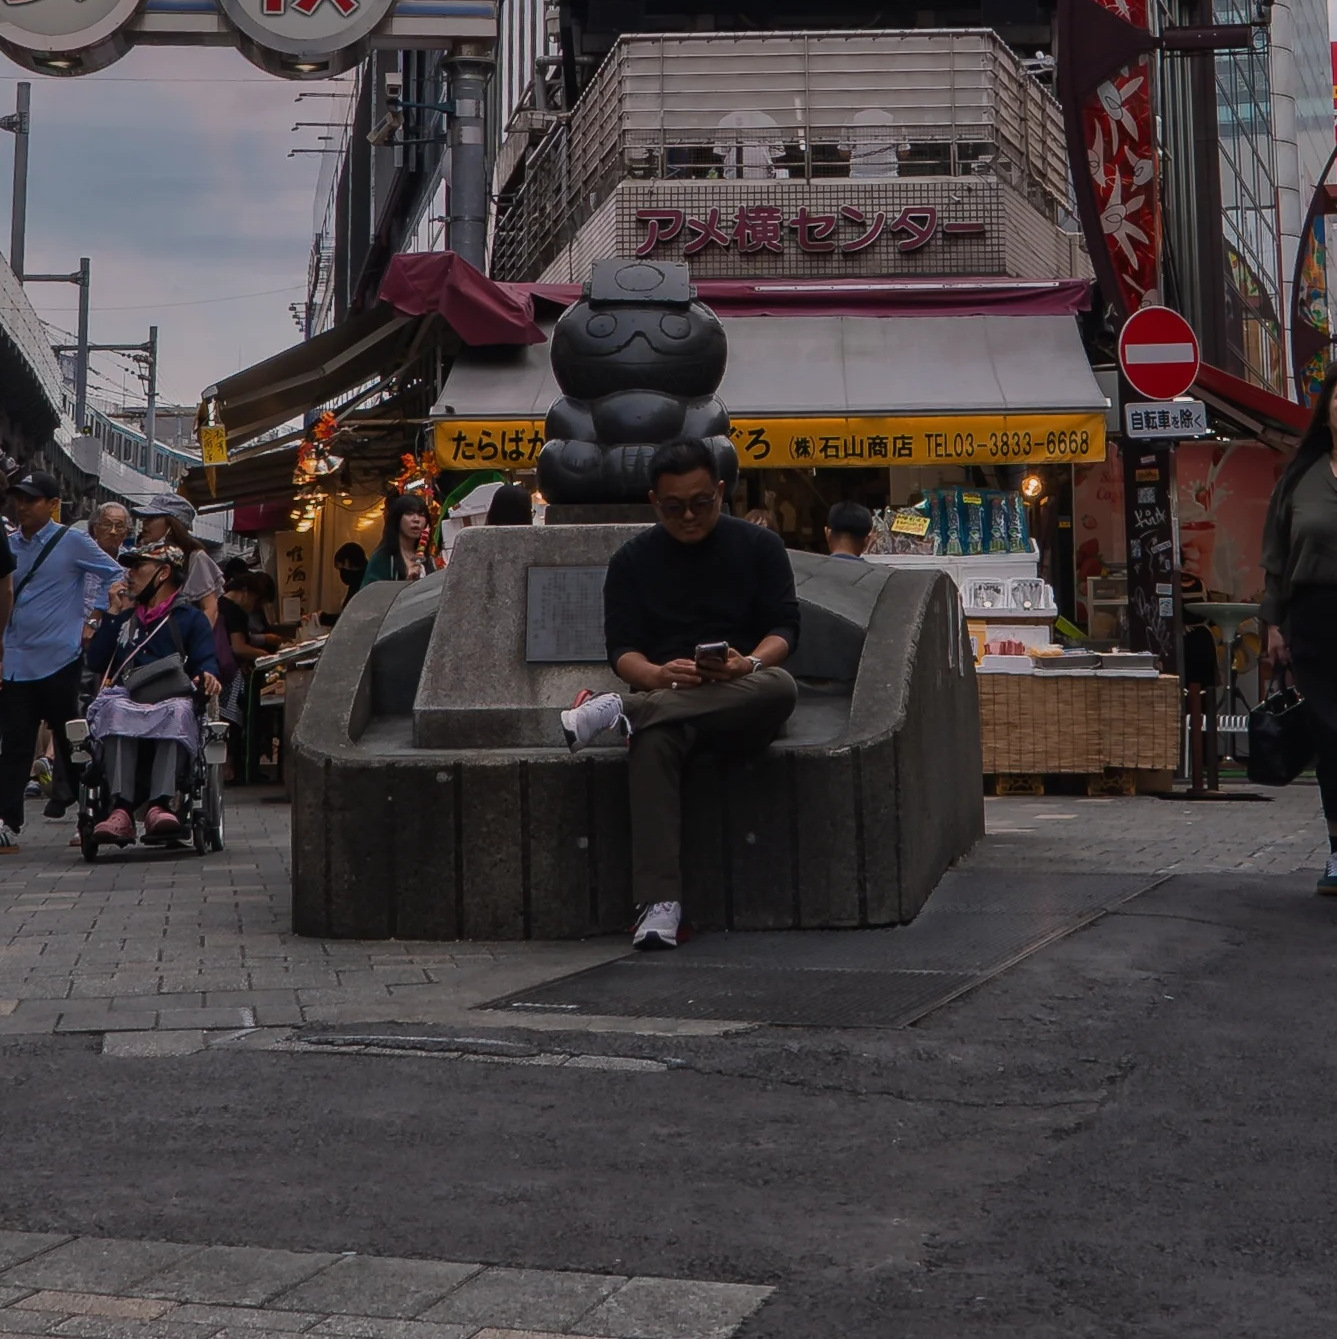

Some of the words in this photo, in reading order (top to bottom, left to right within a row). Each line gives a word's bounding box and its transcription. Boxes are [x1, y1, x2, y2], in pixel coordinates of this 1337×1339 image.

[634, 204, 985, 256] アメ横センター
[1130, 409, 1203, 431] 自転車を除く
[924, 431, 1090, 458] TEL03-3833-6668
